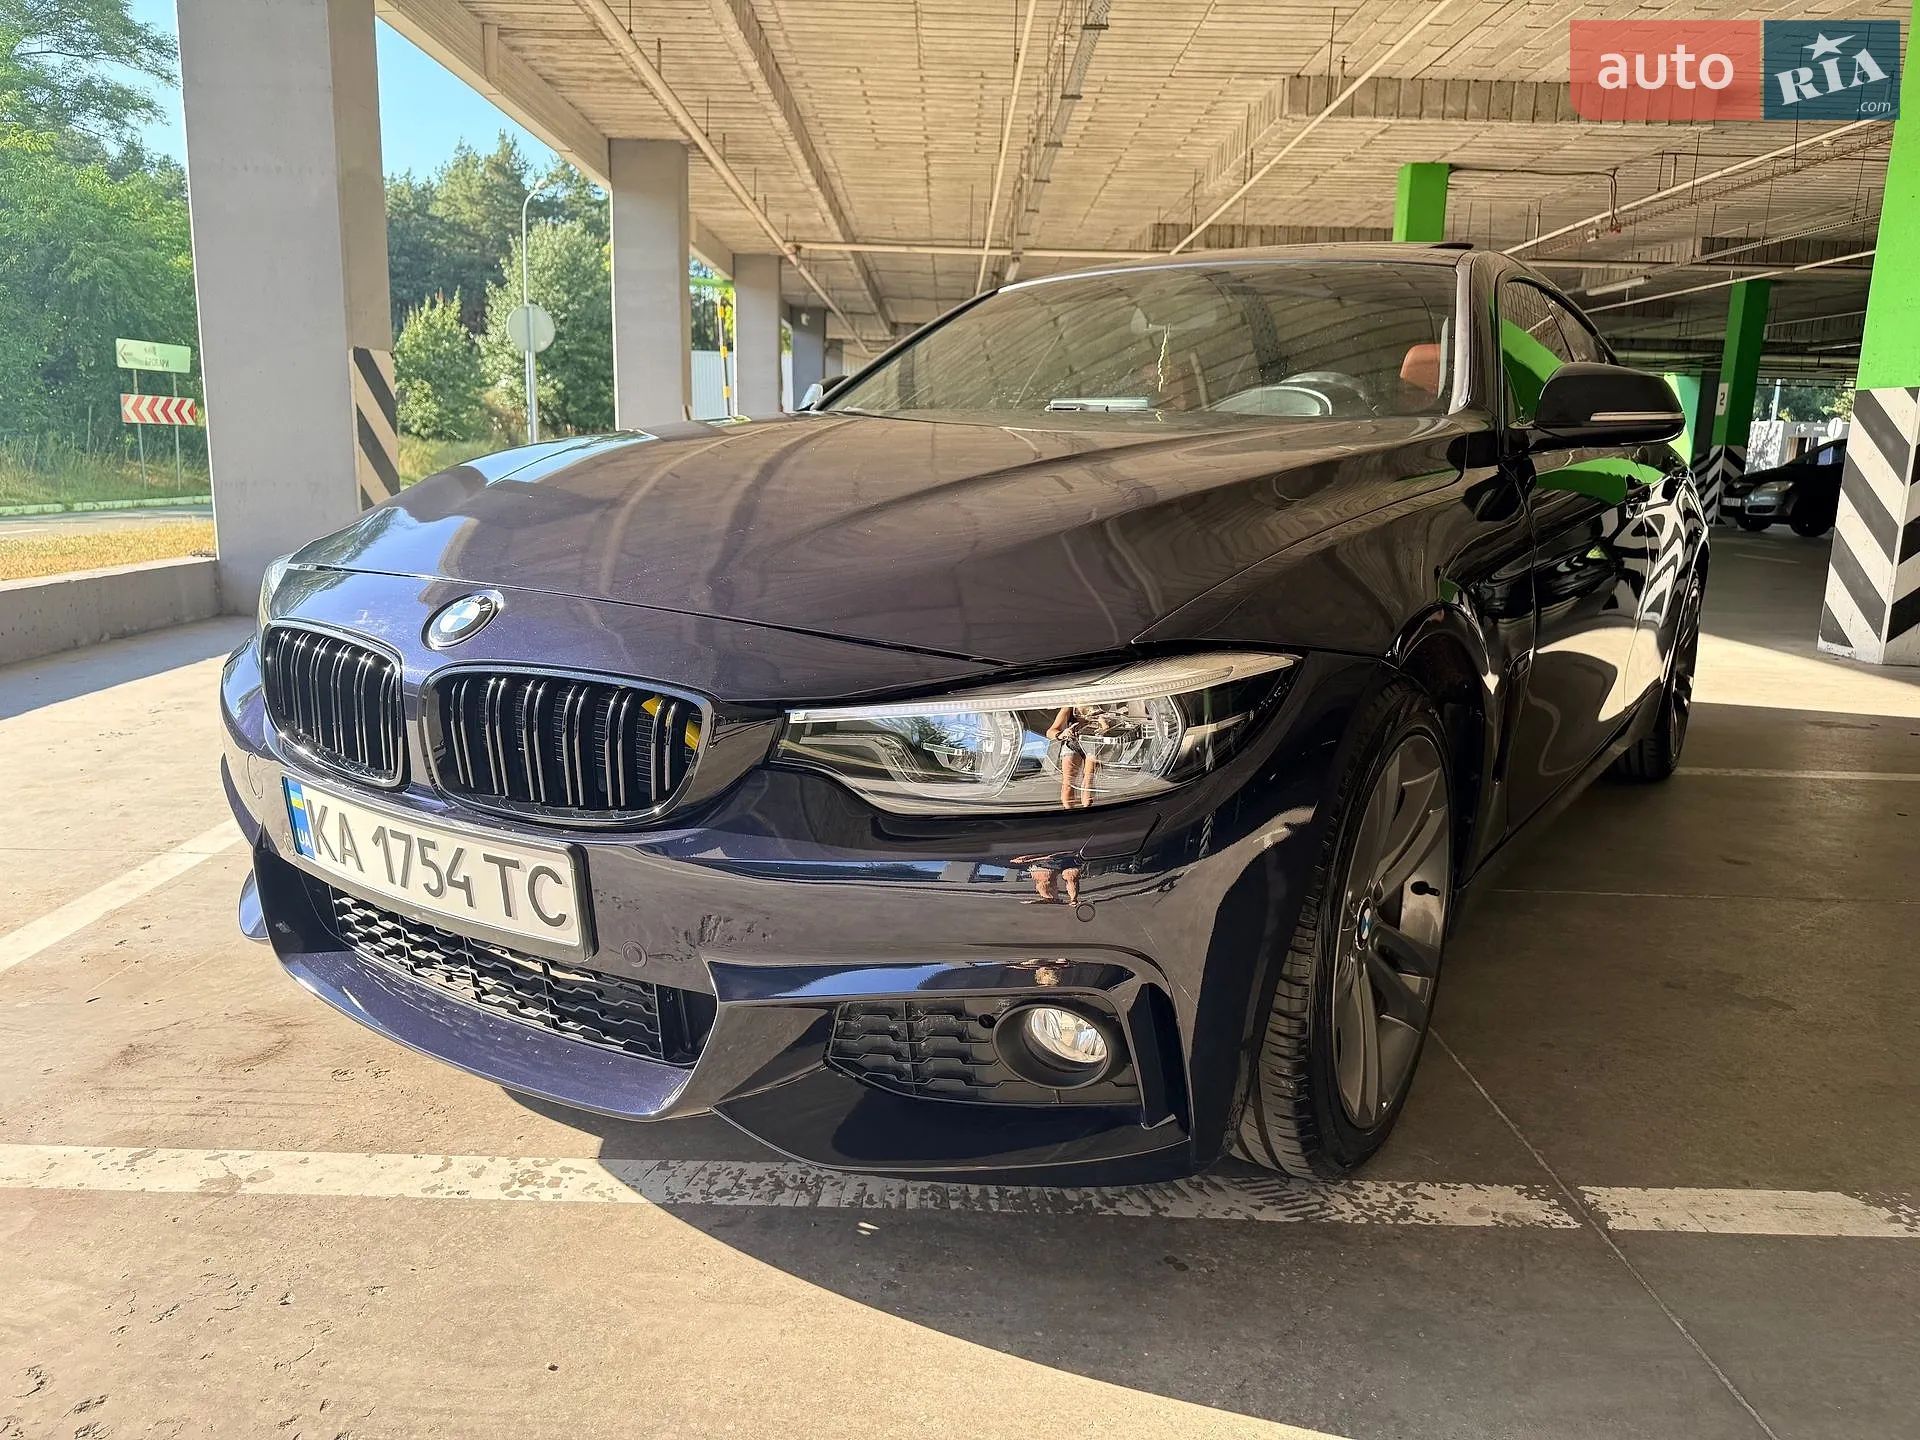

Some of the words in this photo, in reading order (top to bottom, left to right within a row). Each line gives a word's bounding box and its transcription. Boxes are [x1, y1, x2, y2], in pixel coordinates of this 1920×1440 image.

[1719, 391, 1726, 406] 2
[296, 827, 313, 850] UA
[305, 799, 364, 873] KA
[371, 825, 476, 909] 1754
[483, 853, 568, 928] TC
